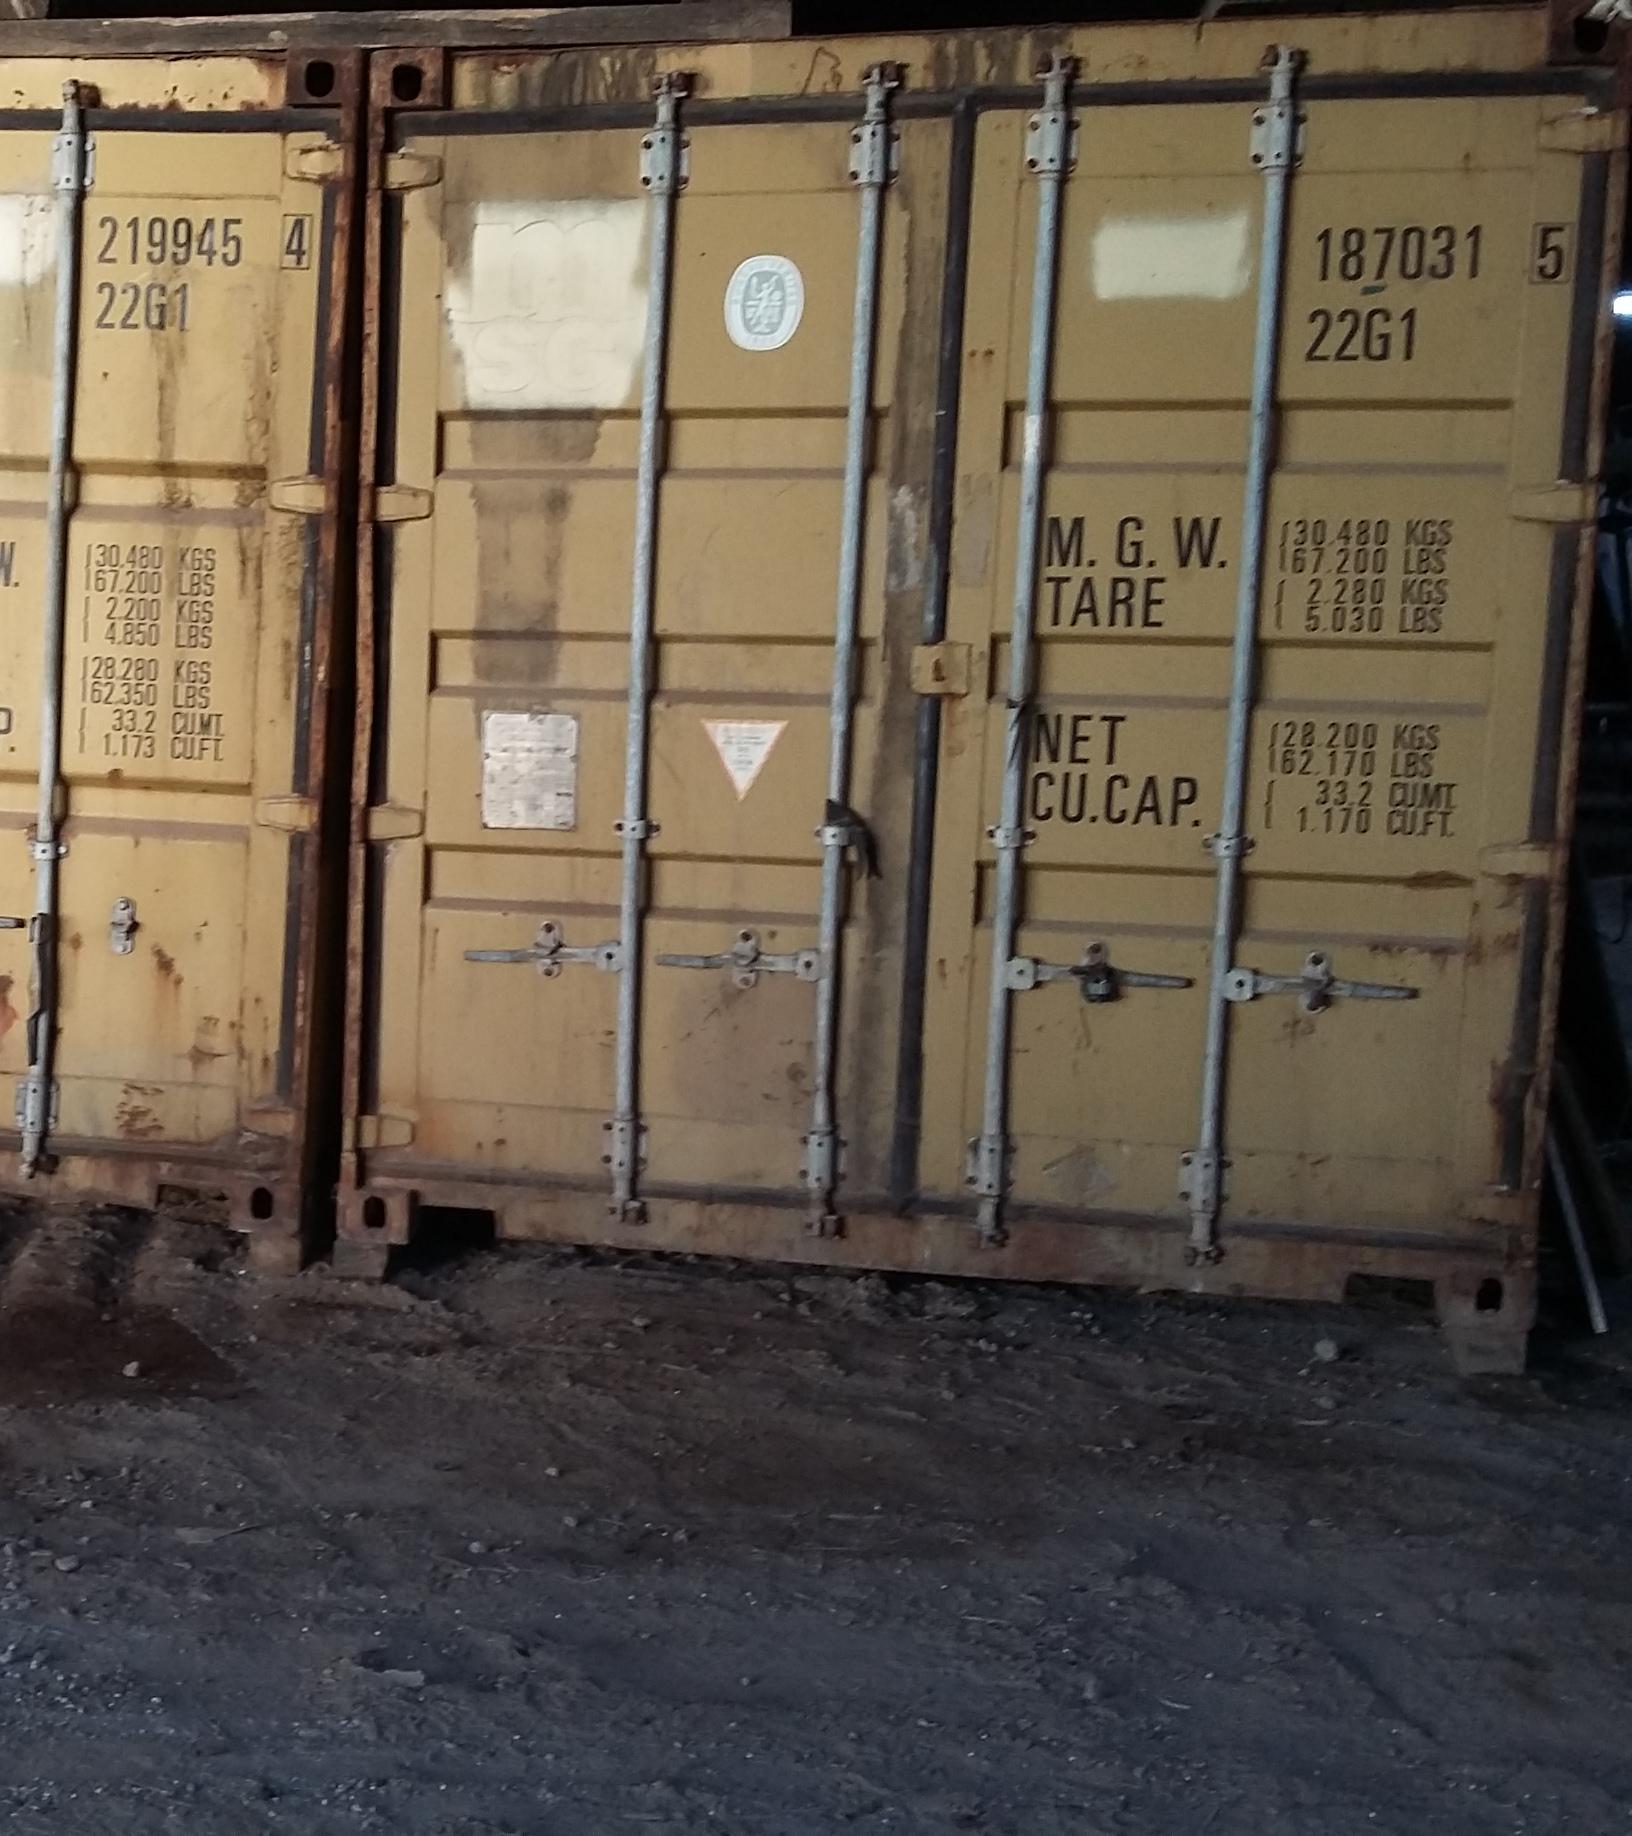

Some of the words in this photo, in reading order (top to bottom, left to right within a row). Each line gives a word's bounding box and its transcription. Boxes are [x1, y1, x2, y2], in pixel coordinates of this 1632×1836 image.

[98, 216, 243, 267] 219945
[285, 217, 307, 267] 4
[1316, 225, 1483, 282] 187031
[1538, 226, 1566, 280] 5
[96, 282, 190, 332] 22G1
[1305, 307, 1419, 362] 22G1
[1293, 519, 1390, 546] 30.480
[1406, 519, 1454, 546] KGS
[95, 544, 163, 570] 30.480
[178, 547, 216, 572] KGS
[1291, 547, 1388, 575] 67.200
[1404, 548, 1448, 575] LBS
[94, 568, 162, 595] 67.200
[177, 571, 216, 597] LBS
[1306, 578, 1386, 605] 2.280
[1401, 578, 1450, 605] KGS
[176, 599, 214, 624] KGS
[1045, 577, 1167, 628] TARE
[1305, 606, 1384, 633] 5.030
[1399, 606, 1443, 633] LBS
[174, 623, 213, 649] LBS
[174, 660, 212, 685] KGS
[172, 684, 211, 709] LBS
[111, 708, 157, 733] 33.2
[104, 732, 156, 759] 1.173
[1032, 714, 1127, 765] NET
[1393, 724, 1441, 750] KGS
[1280, 749, 1376, 777] 62.170
[1391, 752, 1435, 778] LBS
[1031, 771, 1202, 827] CU.CAP.
[1296, 806, 1372, 834] 1.170
